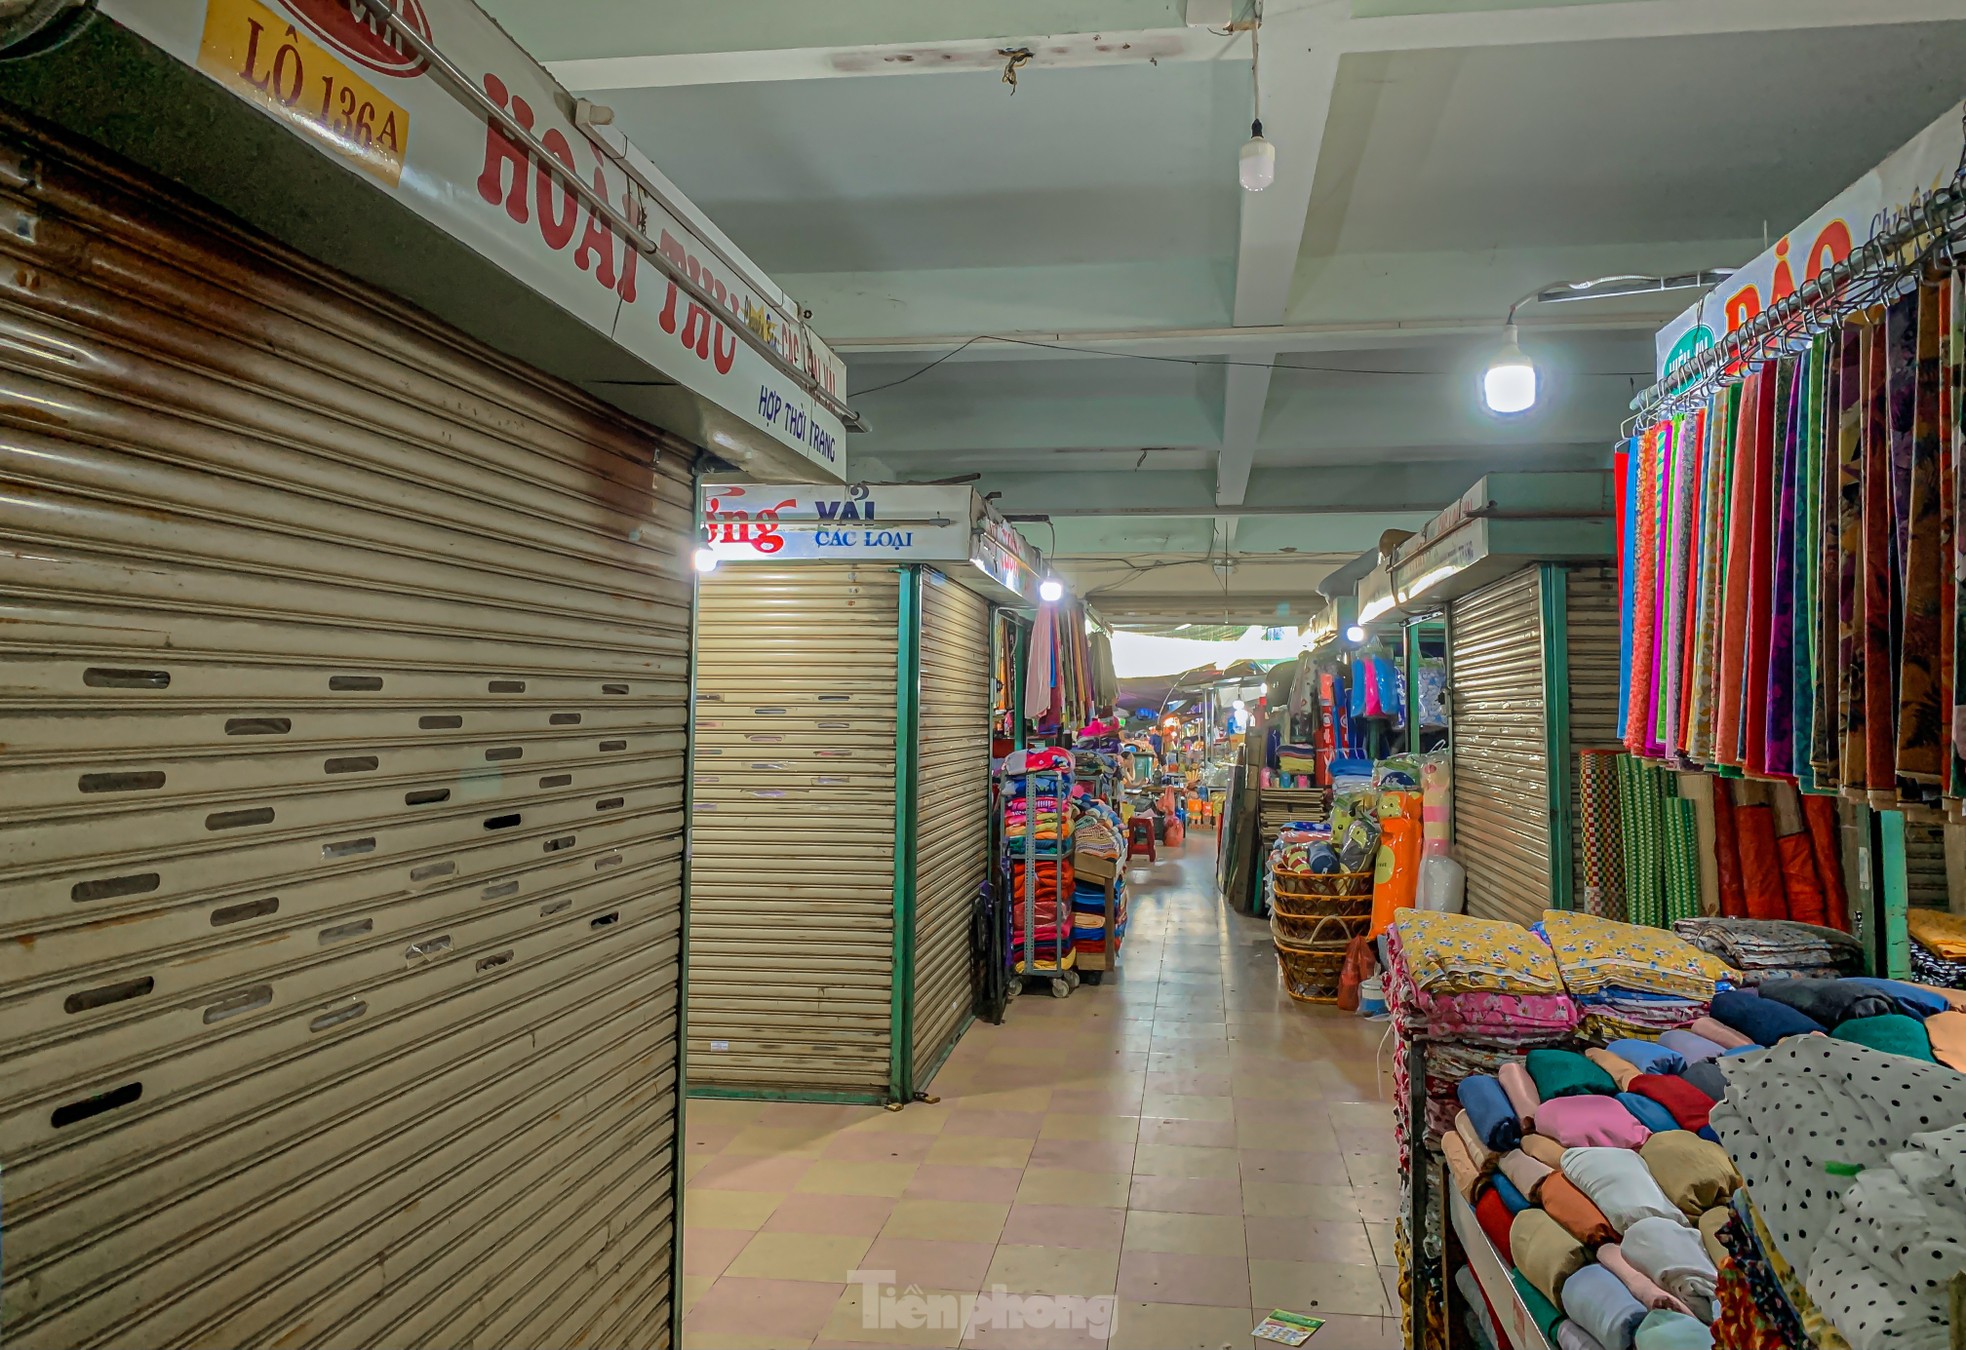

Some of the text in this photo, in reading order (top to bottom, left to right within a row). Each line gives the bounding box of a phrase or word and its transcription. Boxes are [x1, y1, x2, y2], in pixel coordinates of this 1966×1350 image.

[239, 17, 303, 108] LÔ
[477, 72, 638, 303] HOÀI
[758, 385, 836, 463] HỢP THỜI TRANG
[815, 484, 875, 527] VẢI
[815, 529, 913, 550] CÁC LOẠI
